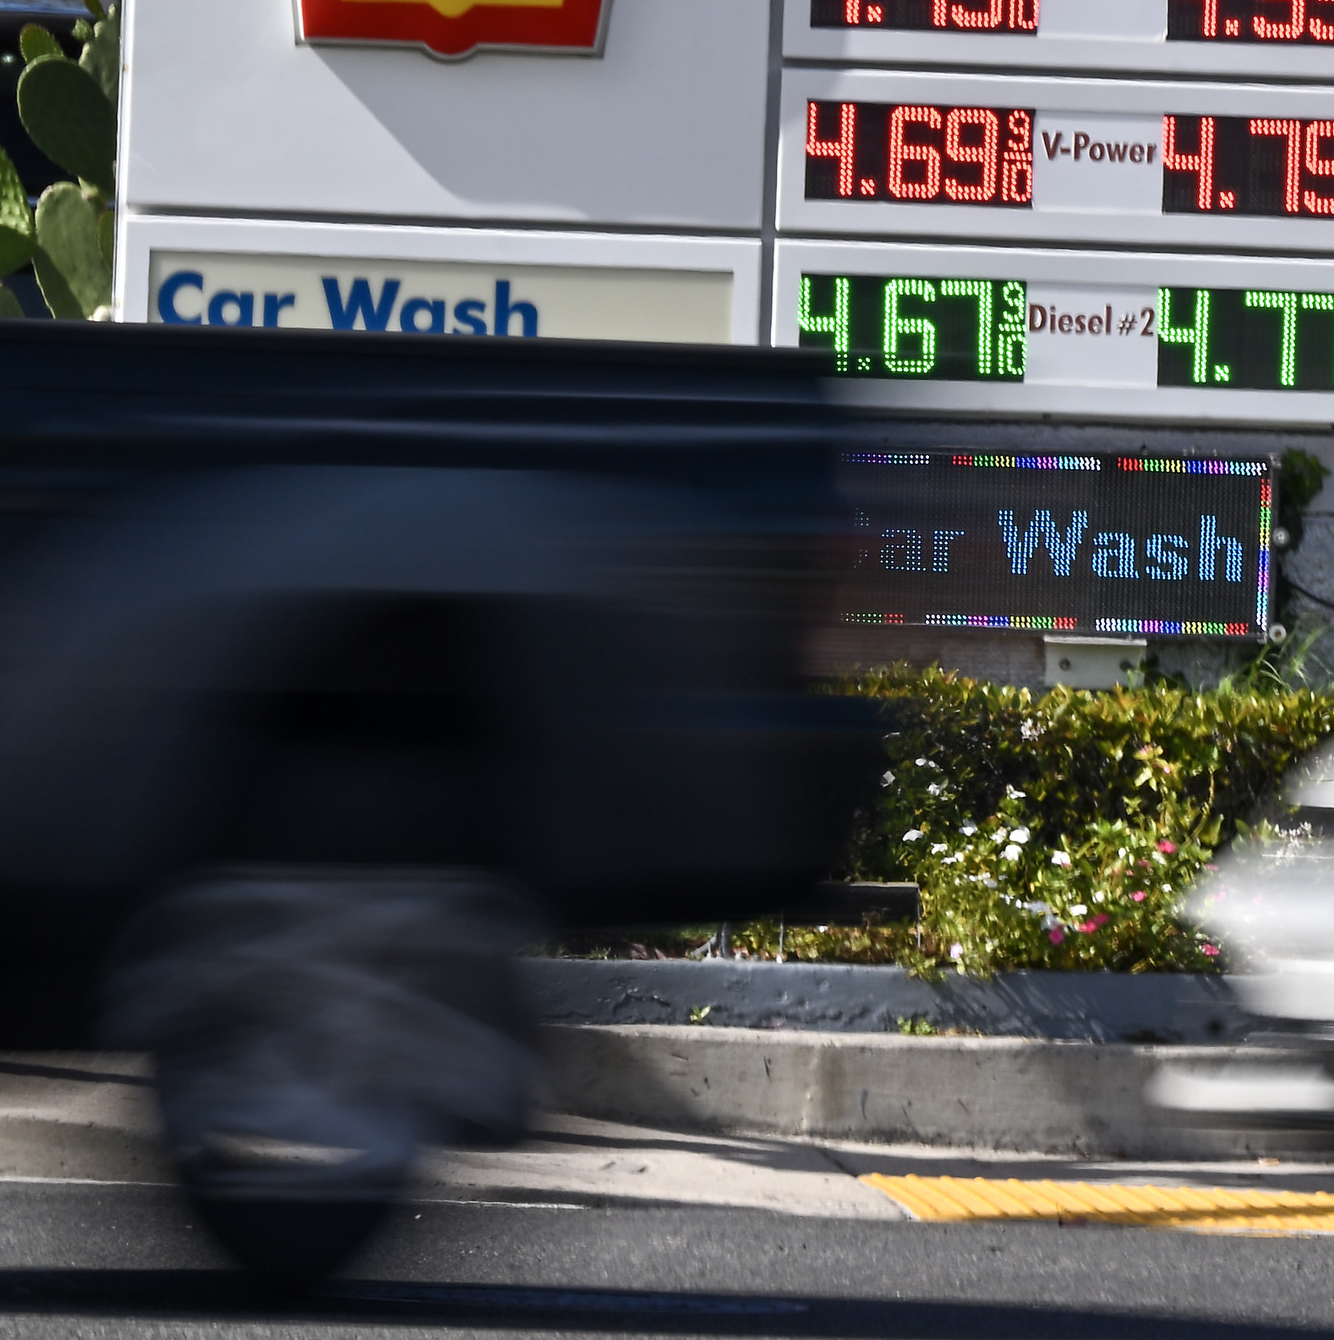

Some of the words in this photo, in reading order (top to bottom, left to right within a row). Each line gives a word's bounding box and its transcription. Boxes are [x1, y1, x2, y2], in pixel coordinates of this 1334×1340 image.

[1042, 131, 1157, 164] V-Power
[157, 271, 296, 328] Car
[321, 275, 539, 338] Wash
[1028, 304, 1112, 336] Diesel
[1118, 307, 1155, 337] #2
[998, 510, 1243, 583] Wash
